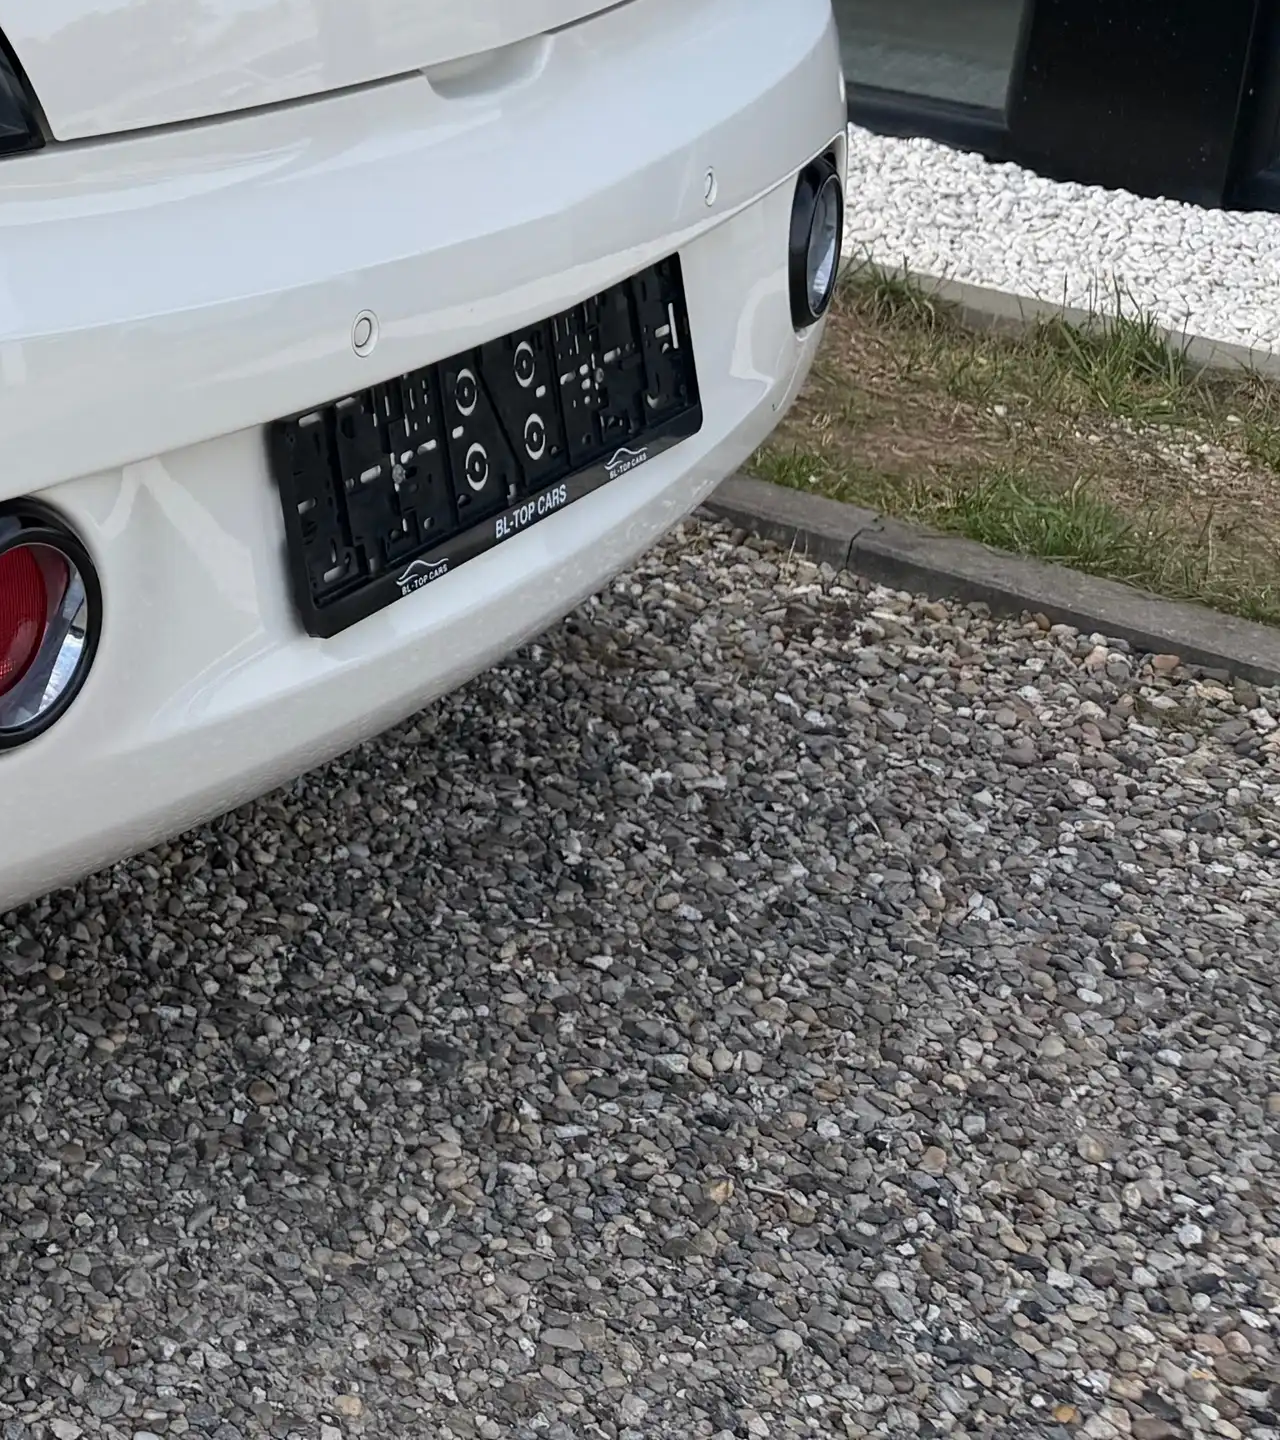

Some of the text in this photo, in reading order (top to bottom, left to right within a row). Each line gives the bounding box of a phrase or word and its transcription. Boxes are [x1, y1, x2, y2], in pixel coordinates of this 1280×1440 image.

[495, 484, 567, 538] BL-TOP CARS
[401, 563, 448, 595] BL-TOP CARS
